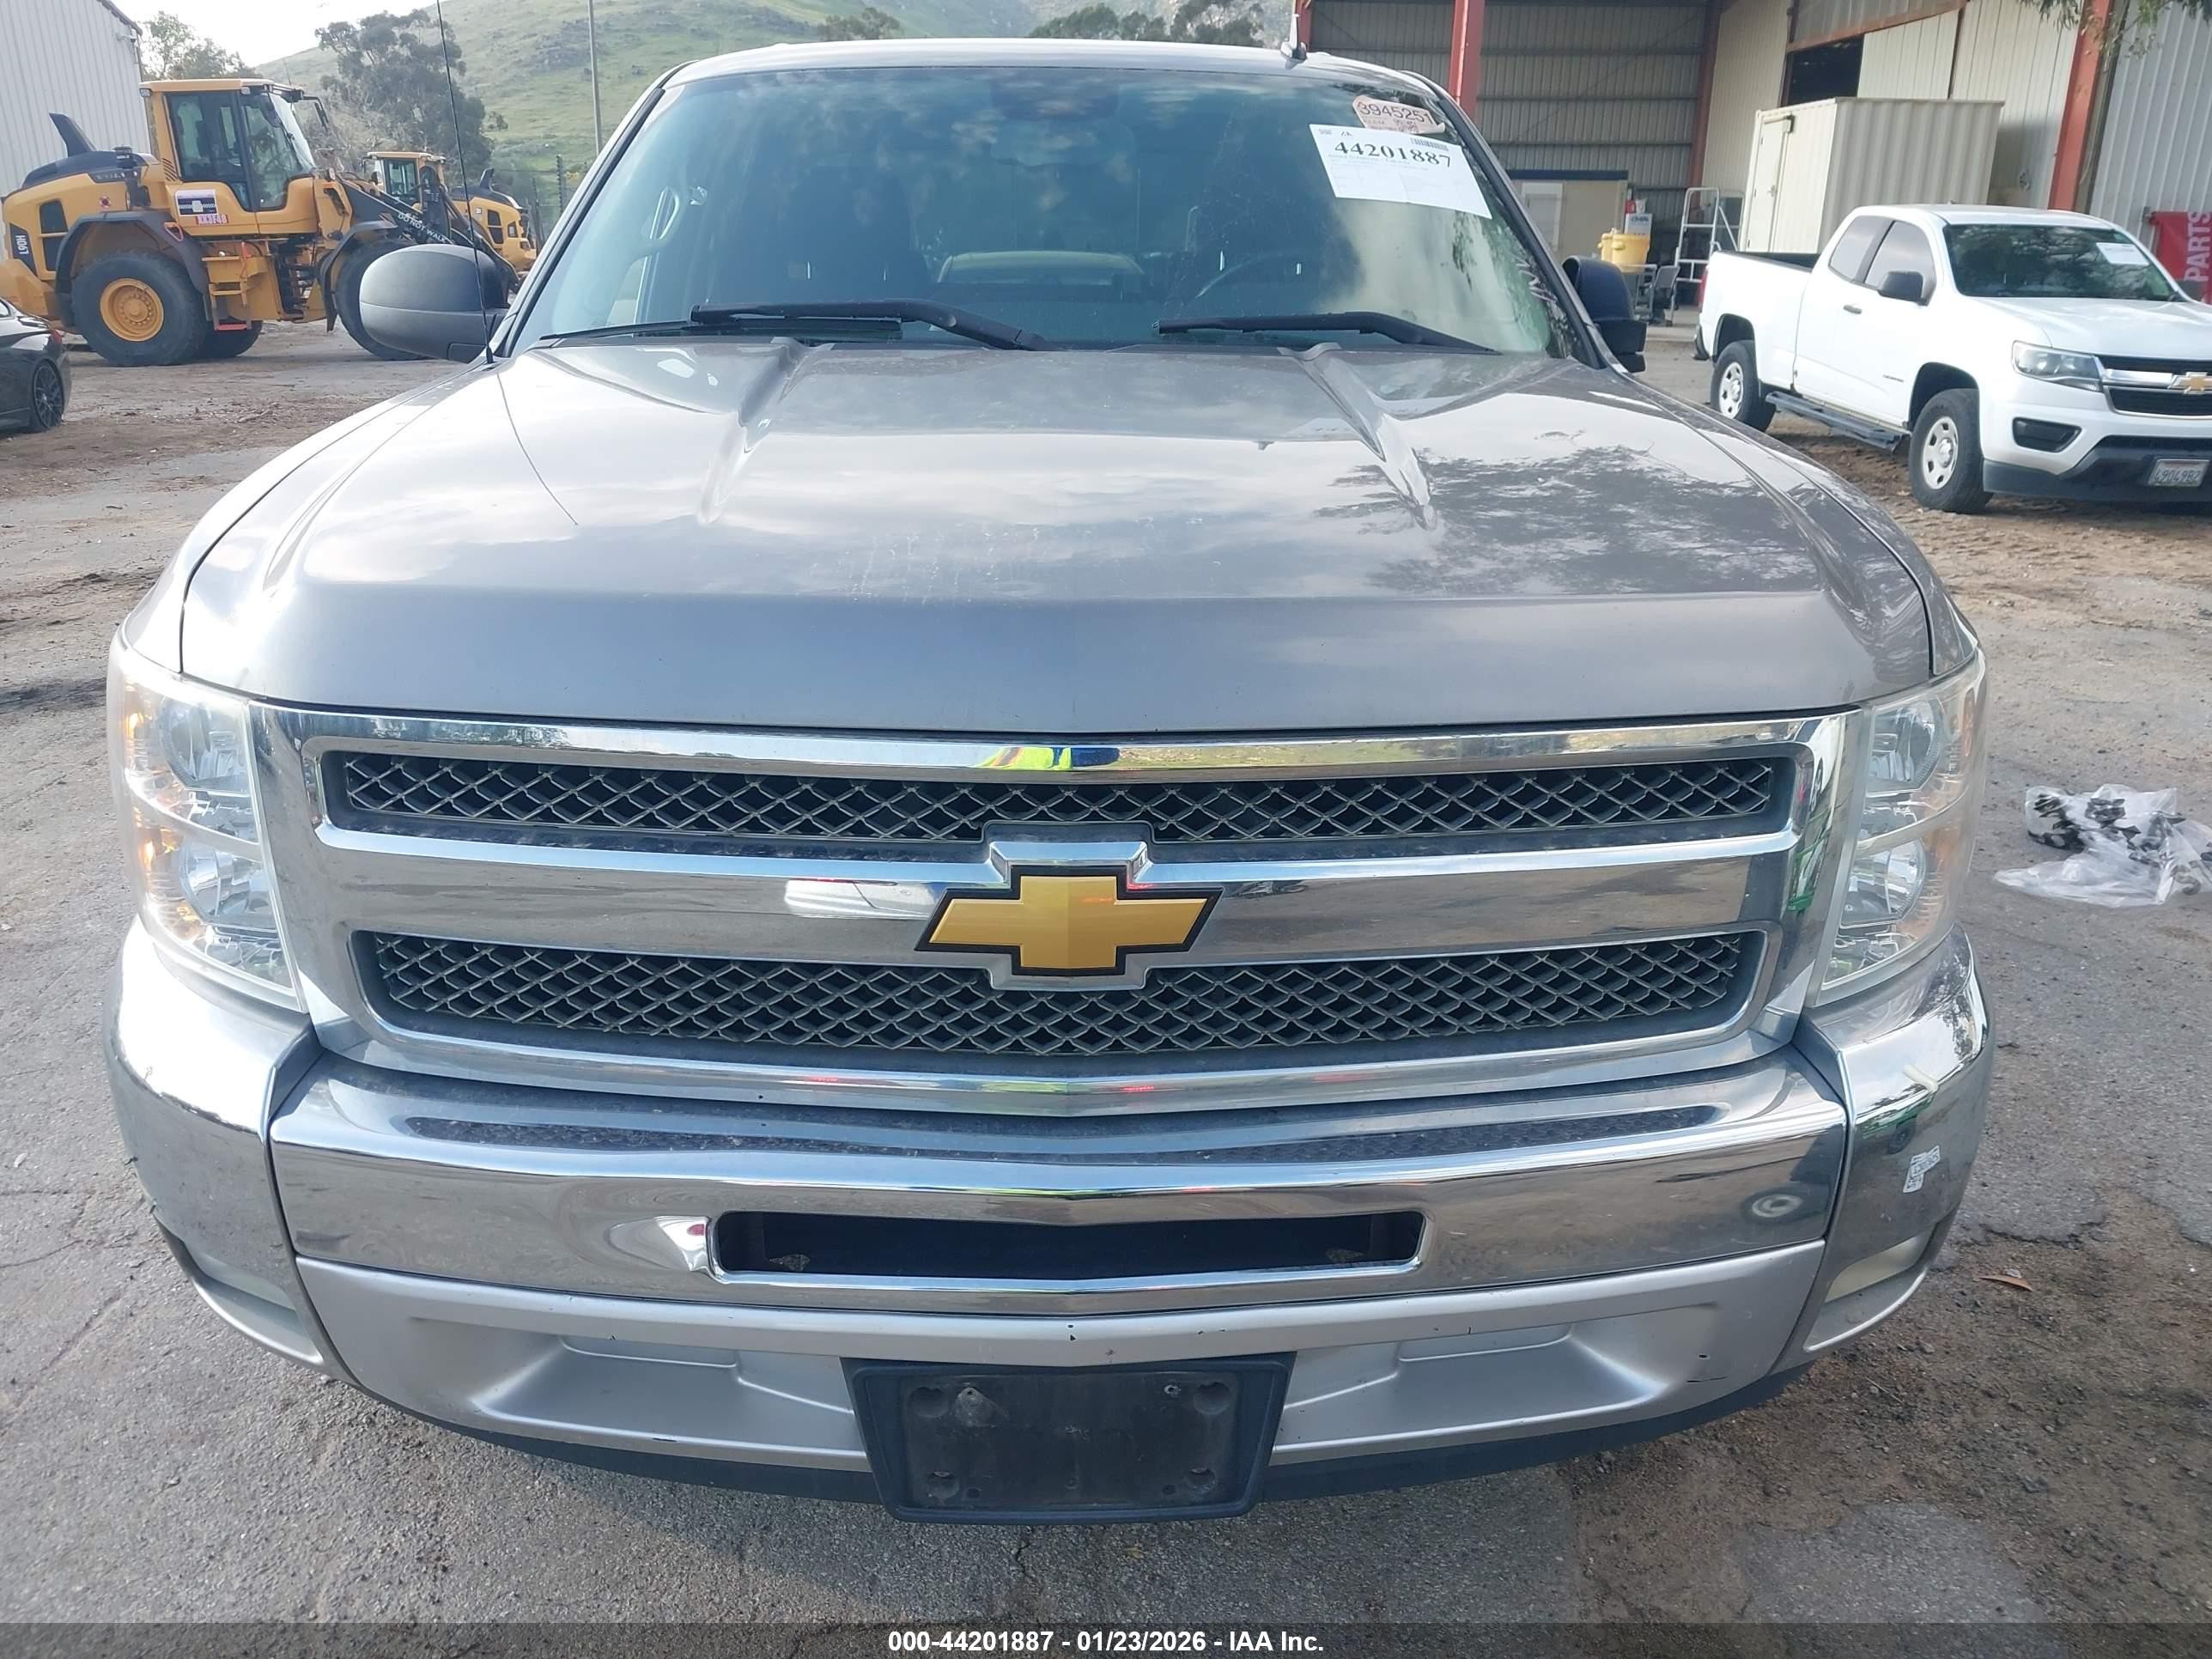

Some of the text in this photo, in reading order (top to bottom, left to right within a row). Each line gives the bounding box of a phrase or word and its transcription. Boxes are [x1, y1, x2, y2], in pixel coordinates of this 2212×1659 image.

[1357, 101, 1433, 125] 3945251
[1334, 142, 1451, 168] 44201887
[398, 213, 410, 222] DO
[410, 220, 426, 231] NOT
[427, 228, 446, 243] WALK
[15, 234, 29, 255] L90H
[2185, 211, 2212, 282] PARTS
